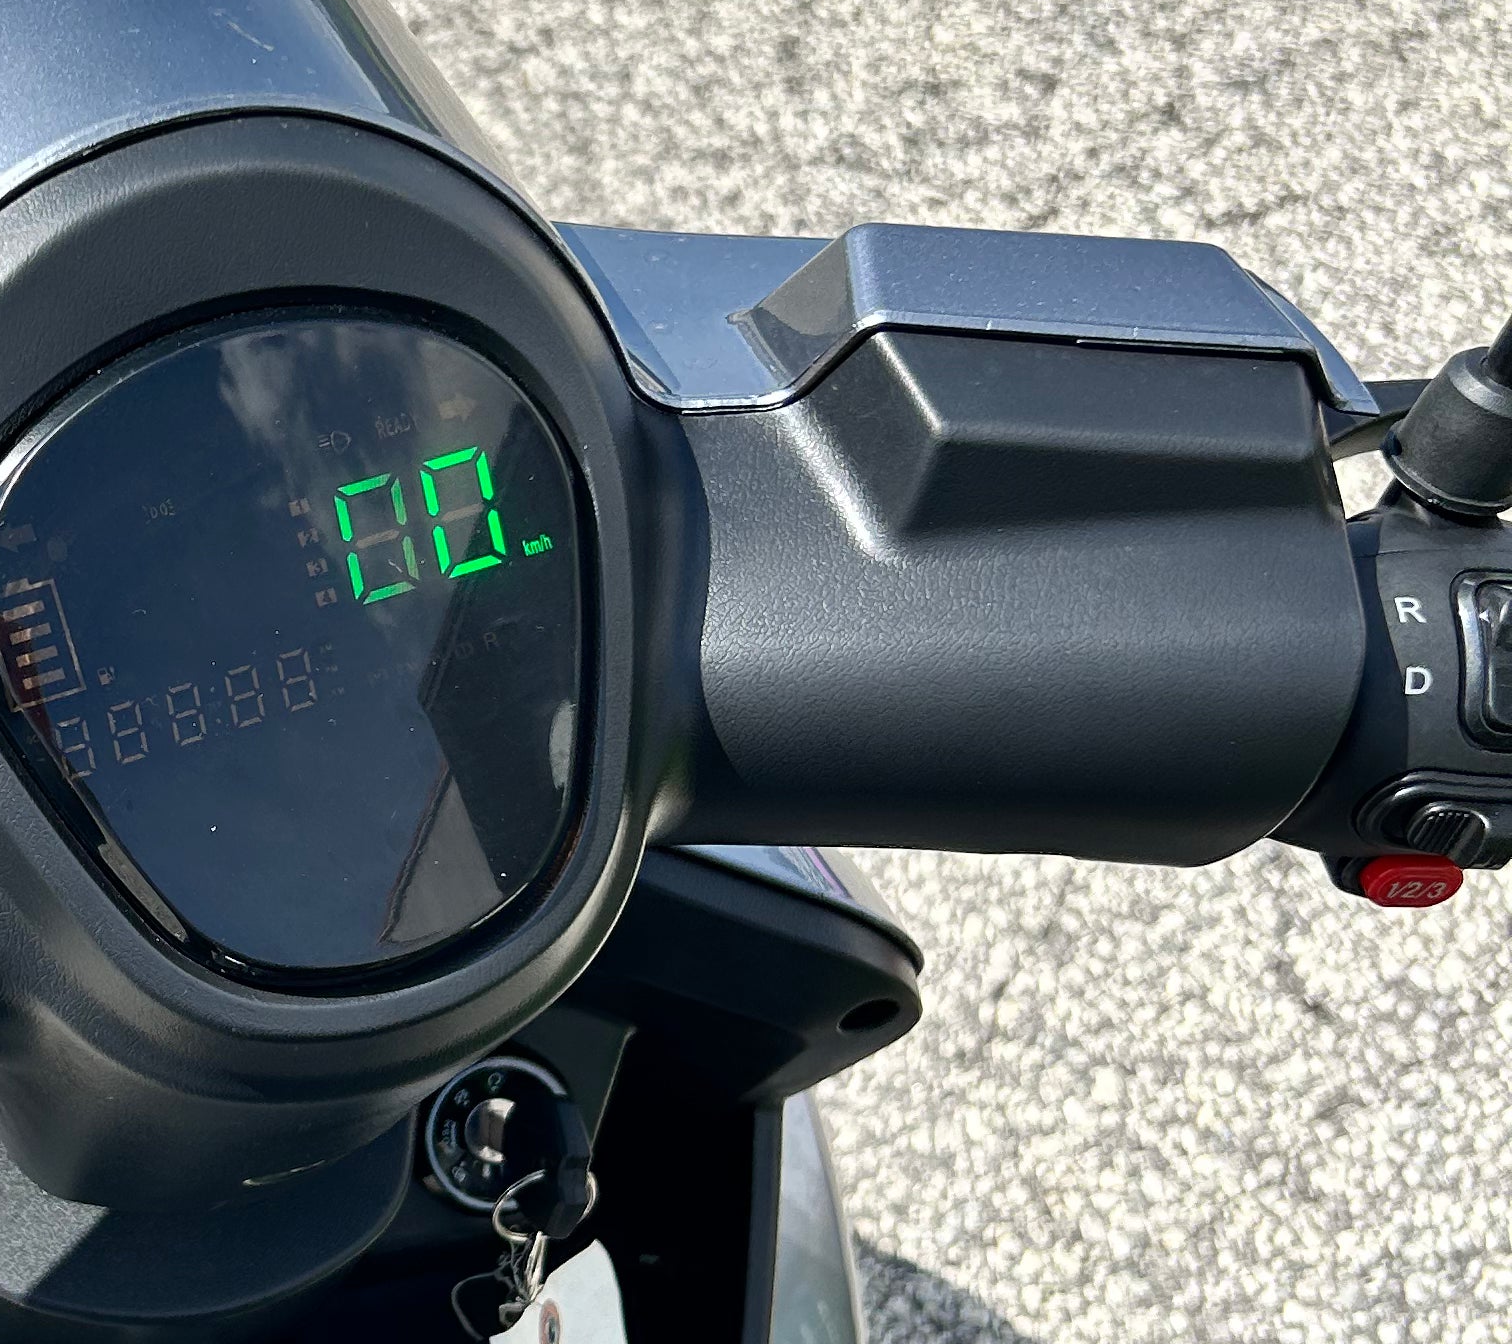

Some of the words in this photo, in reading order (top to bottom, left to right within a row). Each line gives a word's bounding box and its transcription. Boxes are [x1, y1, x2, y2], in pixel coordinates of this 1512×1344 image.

[333, 446, 507, 605] 00
[522, 532, 554, 558] km/h
[1394, 596, 1427, 624] R
[1404, 666, 1433, 696] D
[1386, 880, 1448, 899] 1/2/3
